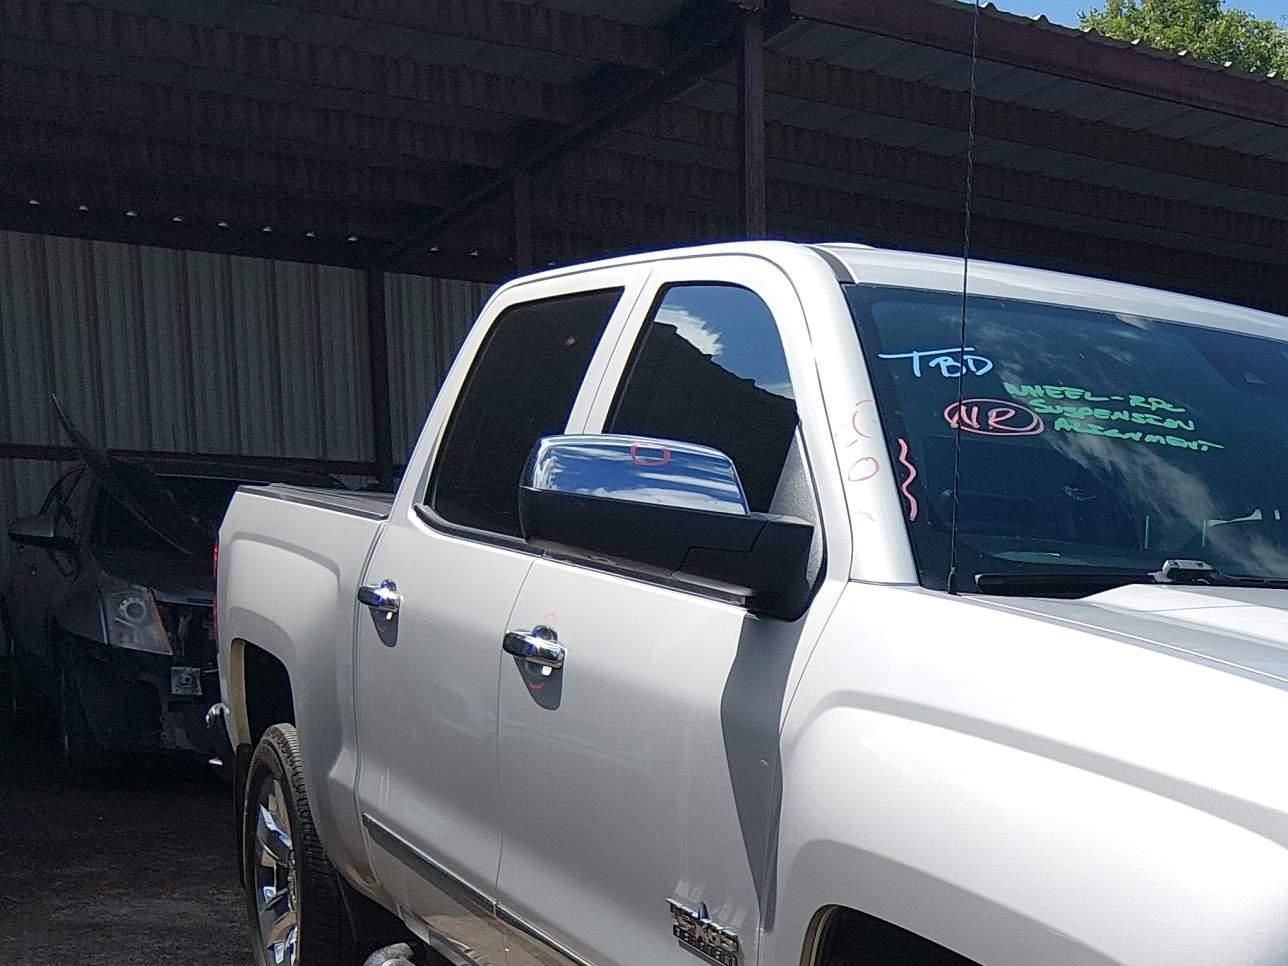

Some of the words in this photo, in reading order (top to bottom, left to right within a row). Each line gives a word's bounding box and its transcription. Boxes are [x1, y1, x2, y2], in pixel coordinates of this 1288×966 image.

[878, 347, 993, 377] TBD
[1029, 399, 1194, 430] SUSPENSION
[1054, 417, 1224, 451] ALIGNMENT
